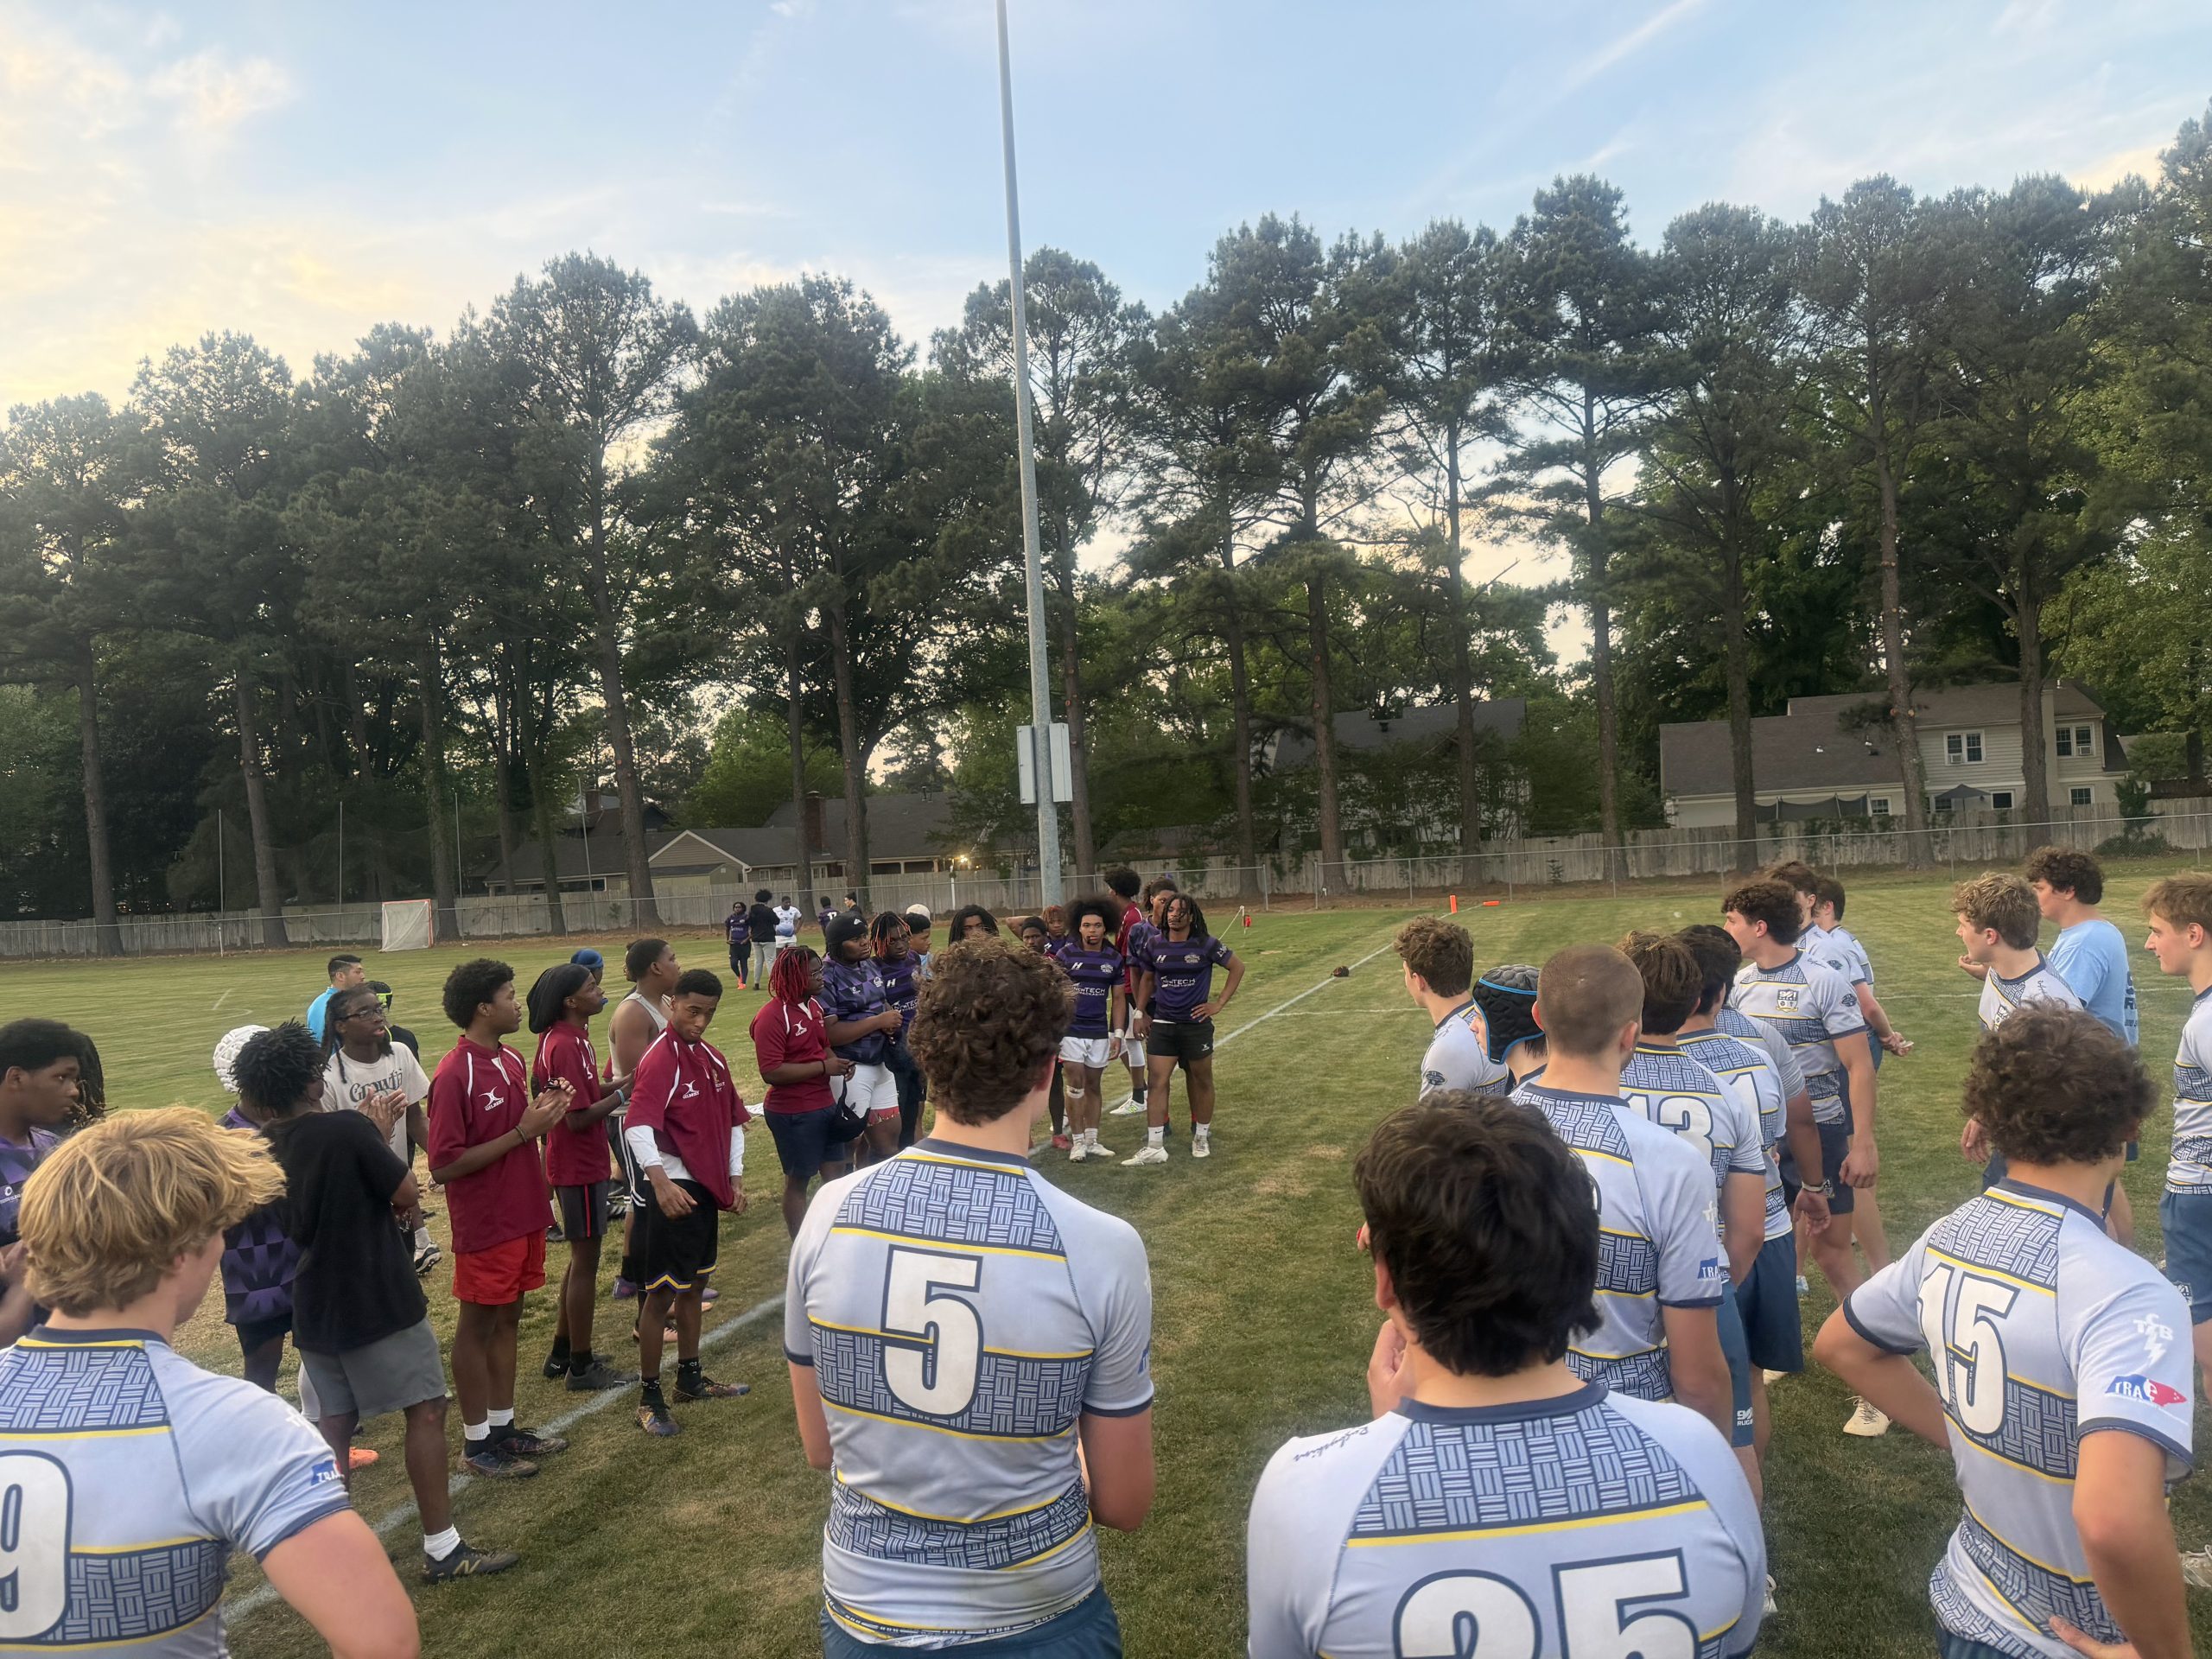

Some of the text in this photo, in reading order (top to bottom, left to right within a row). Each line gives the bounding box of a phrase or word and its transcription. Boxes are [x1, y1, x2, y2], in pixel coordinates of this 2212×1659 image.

[880, 1243, 984, 1421] 5
[1917, 1262, 2021, 1439] 15
[0, 1449, 73, 1643] 9
